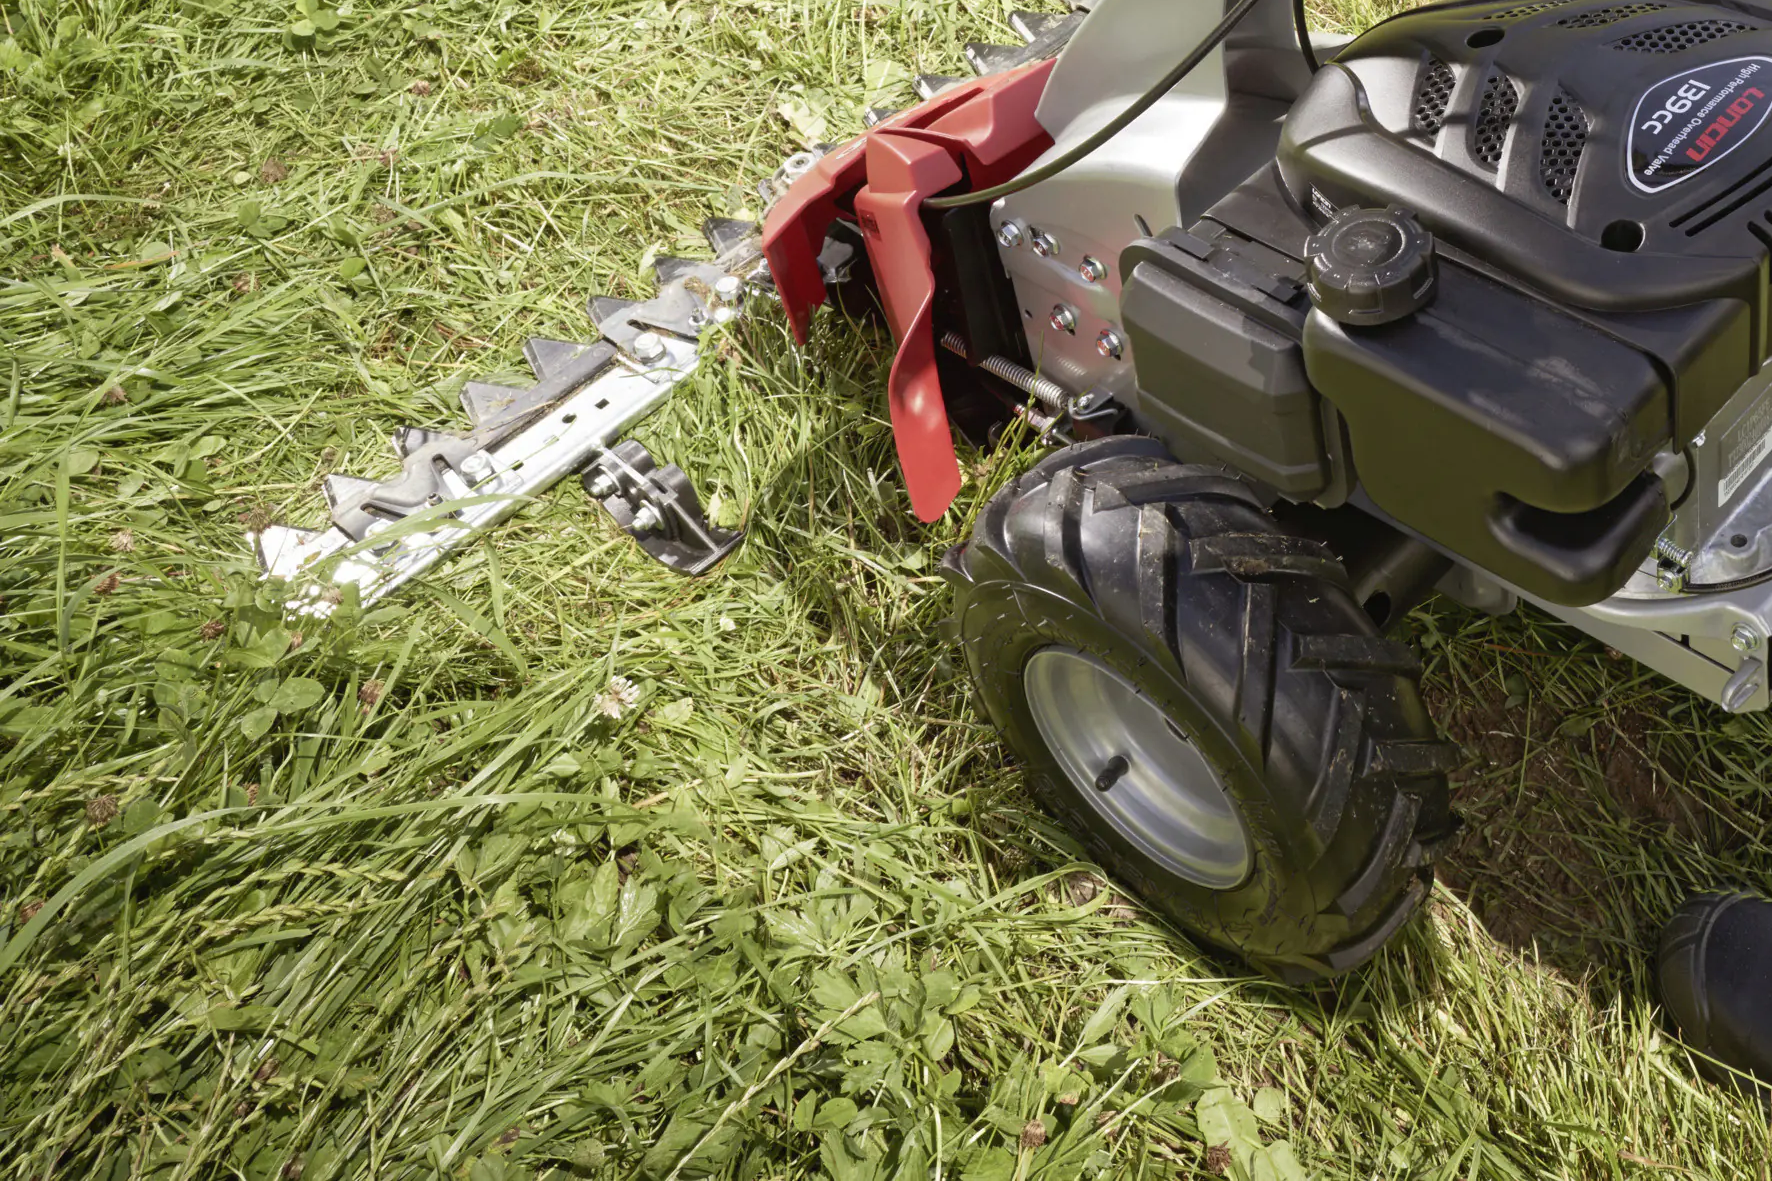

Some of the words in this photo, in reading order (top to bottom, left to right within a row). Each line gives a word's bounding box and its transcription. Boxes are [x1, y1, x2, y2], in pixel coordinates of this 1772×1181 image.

[1737, 63, 1761, 79] High
[1641, 79, 1711, 135] 139cc
[1697, 77, 1745, 118] Performance
[1663, 118, 1702, 155] Overhead
[1644, 154, 1670, 176] Valve
